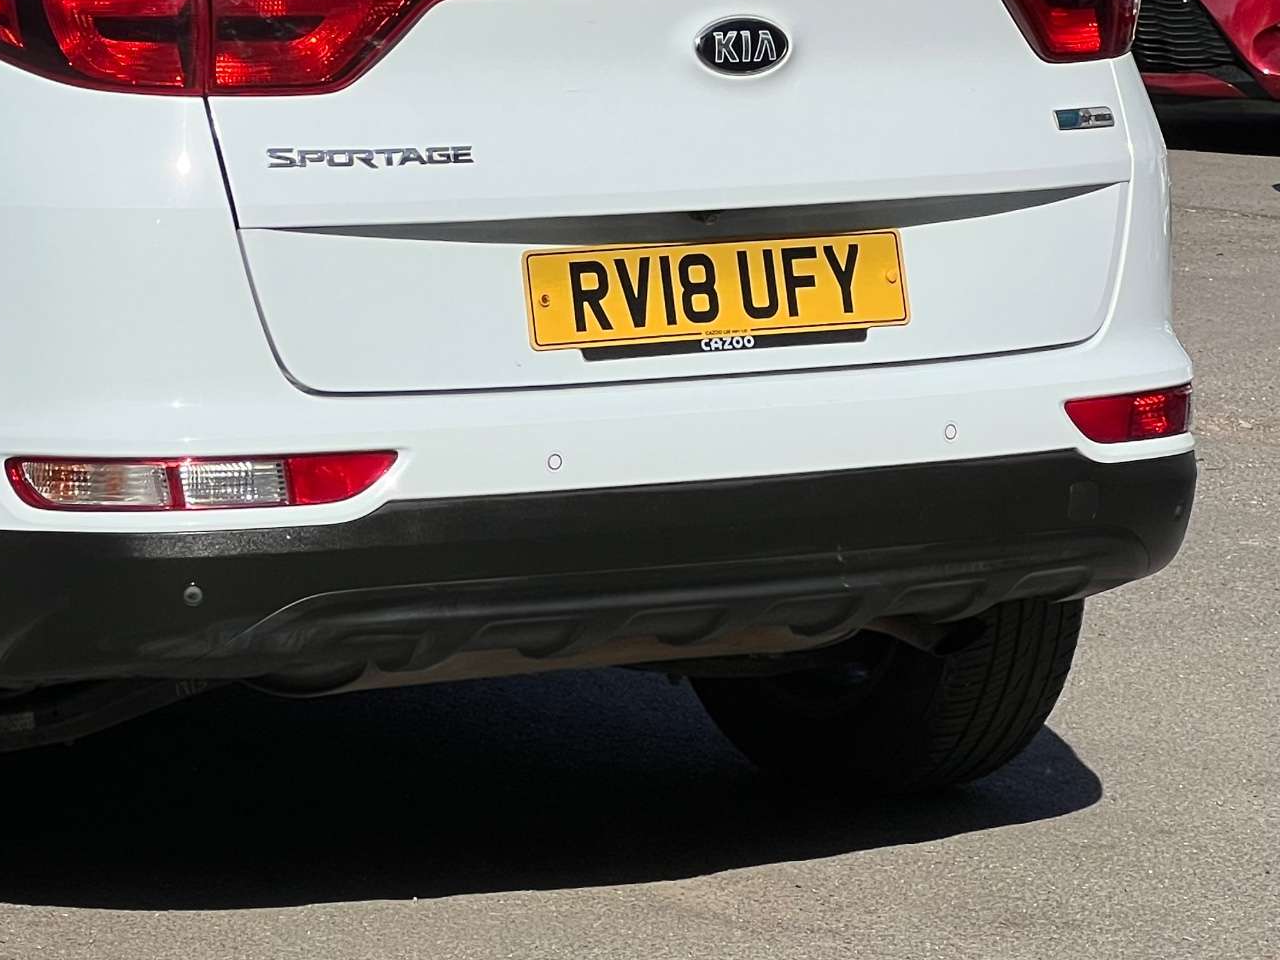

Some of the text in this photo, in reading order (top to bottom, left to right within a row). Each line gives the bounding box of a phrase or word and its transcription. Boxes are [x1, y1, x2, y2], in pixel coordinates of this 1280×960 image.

[713, 30, 777, 63] KIA
[266, 145, 475, 169] SPORTAGE
[569, 243, 860, 332] RV18 UFY
